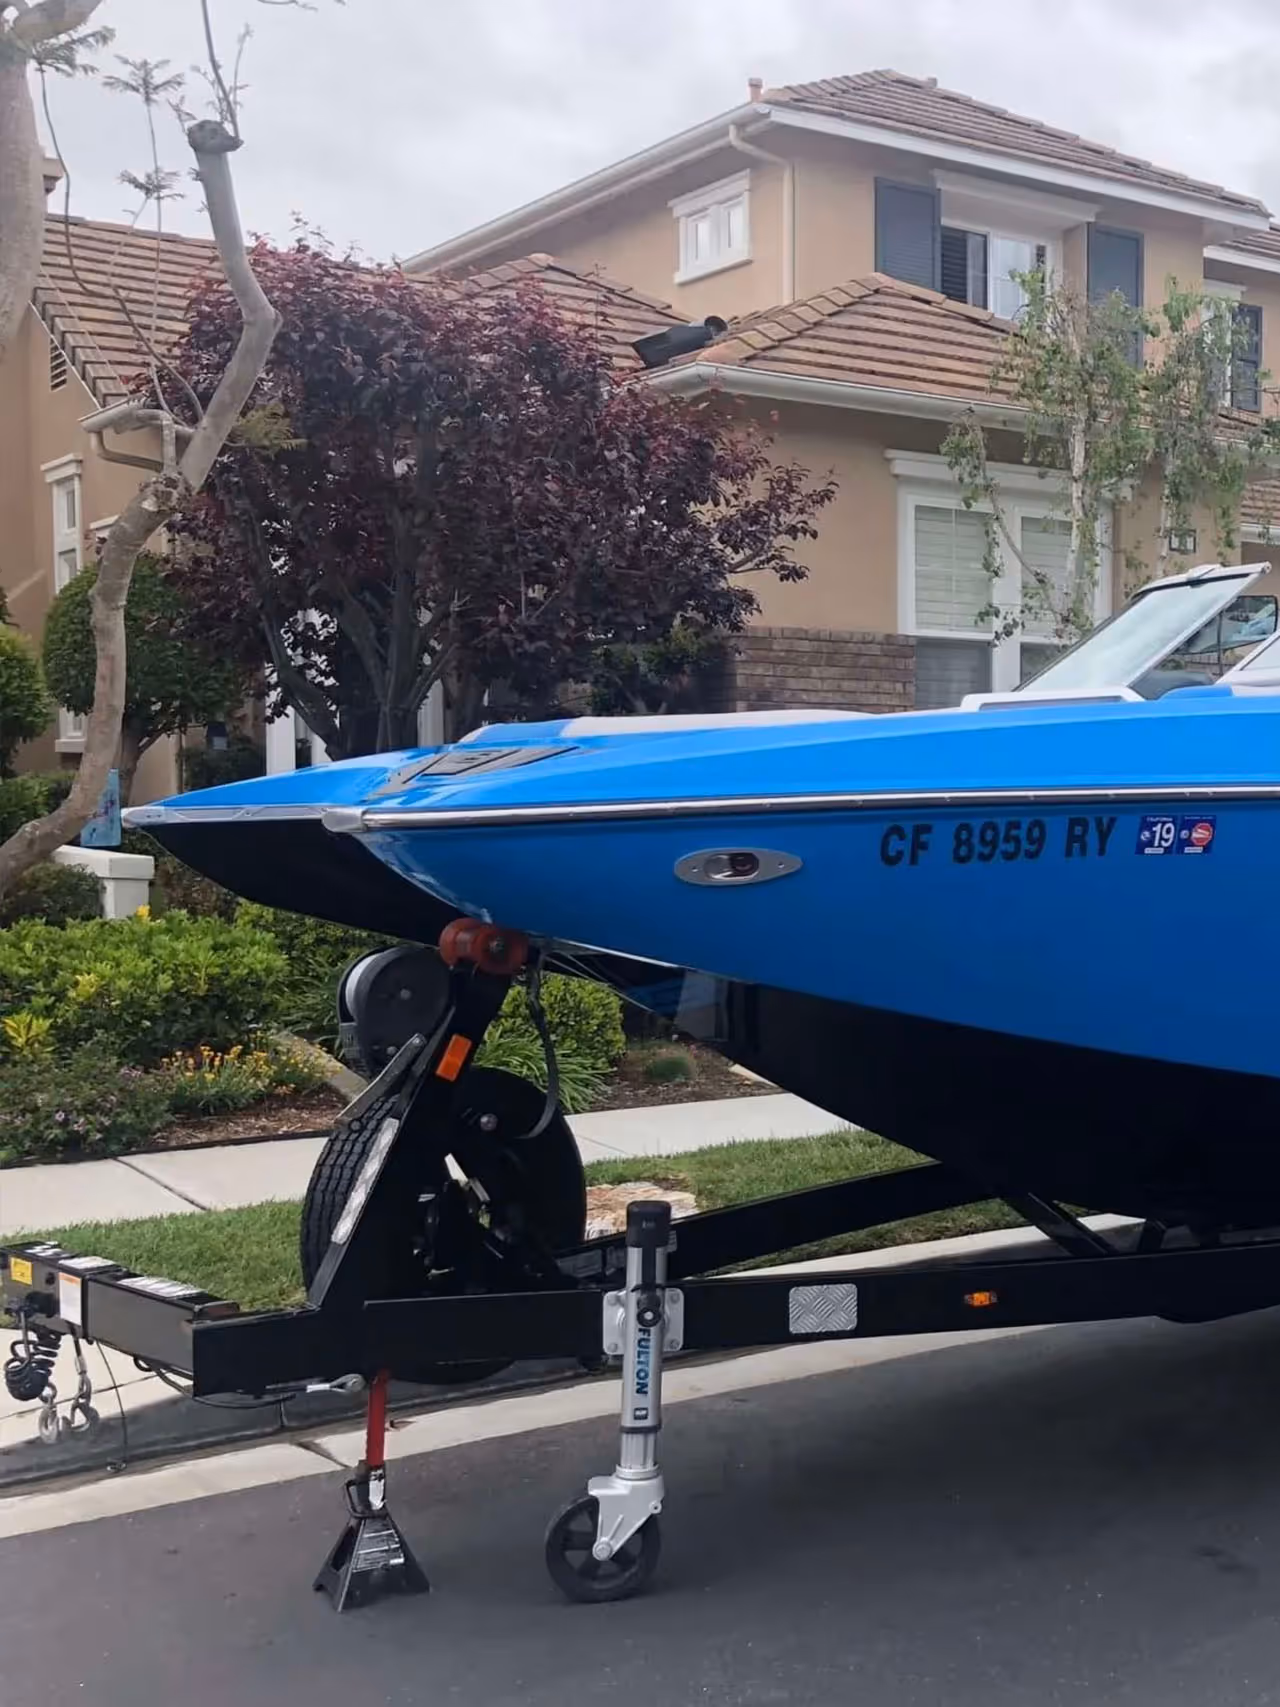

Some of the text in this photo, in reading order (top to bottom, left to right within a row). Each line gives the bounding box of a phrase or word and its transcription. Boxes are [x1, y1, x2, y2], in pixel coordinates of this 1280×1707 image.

[880, 816, 1118, 866] CF 8959 RY
[1152, 822, 1175, 847] 19
[635, 1327, 651, 1395] FULTON
